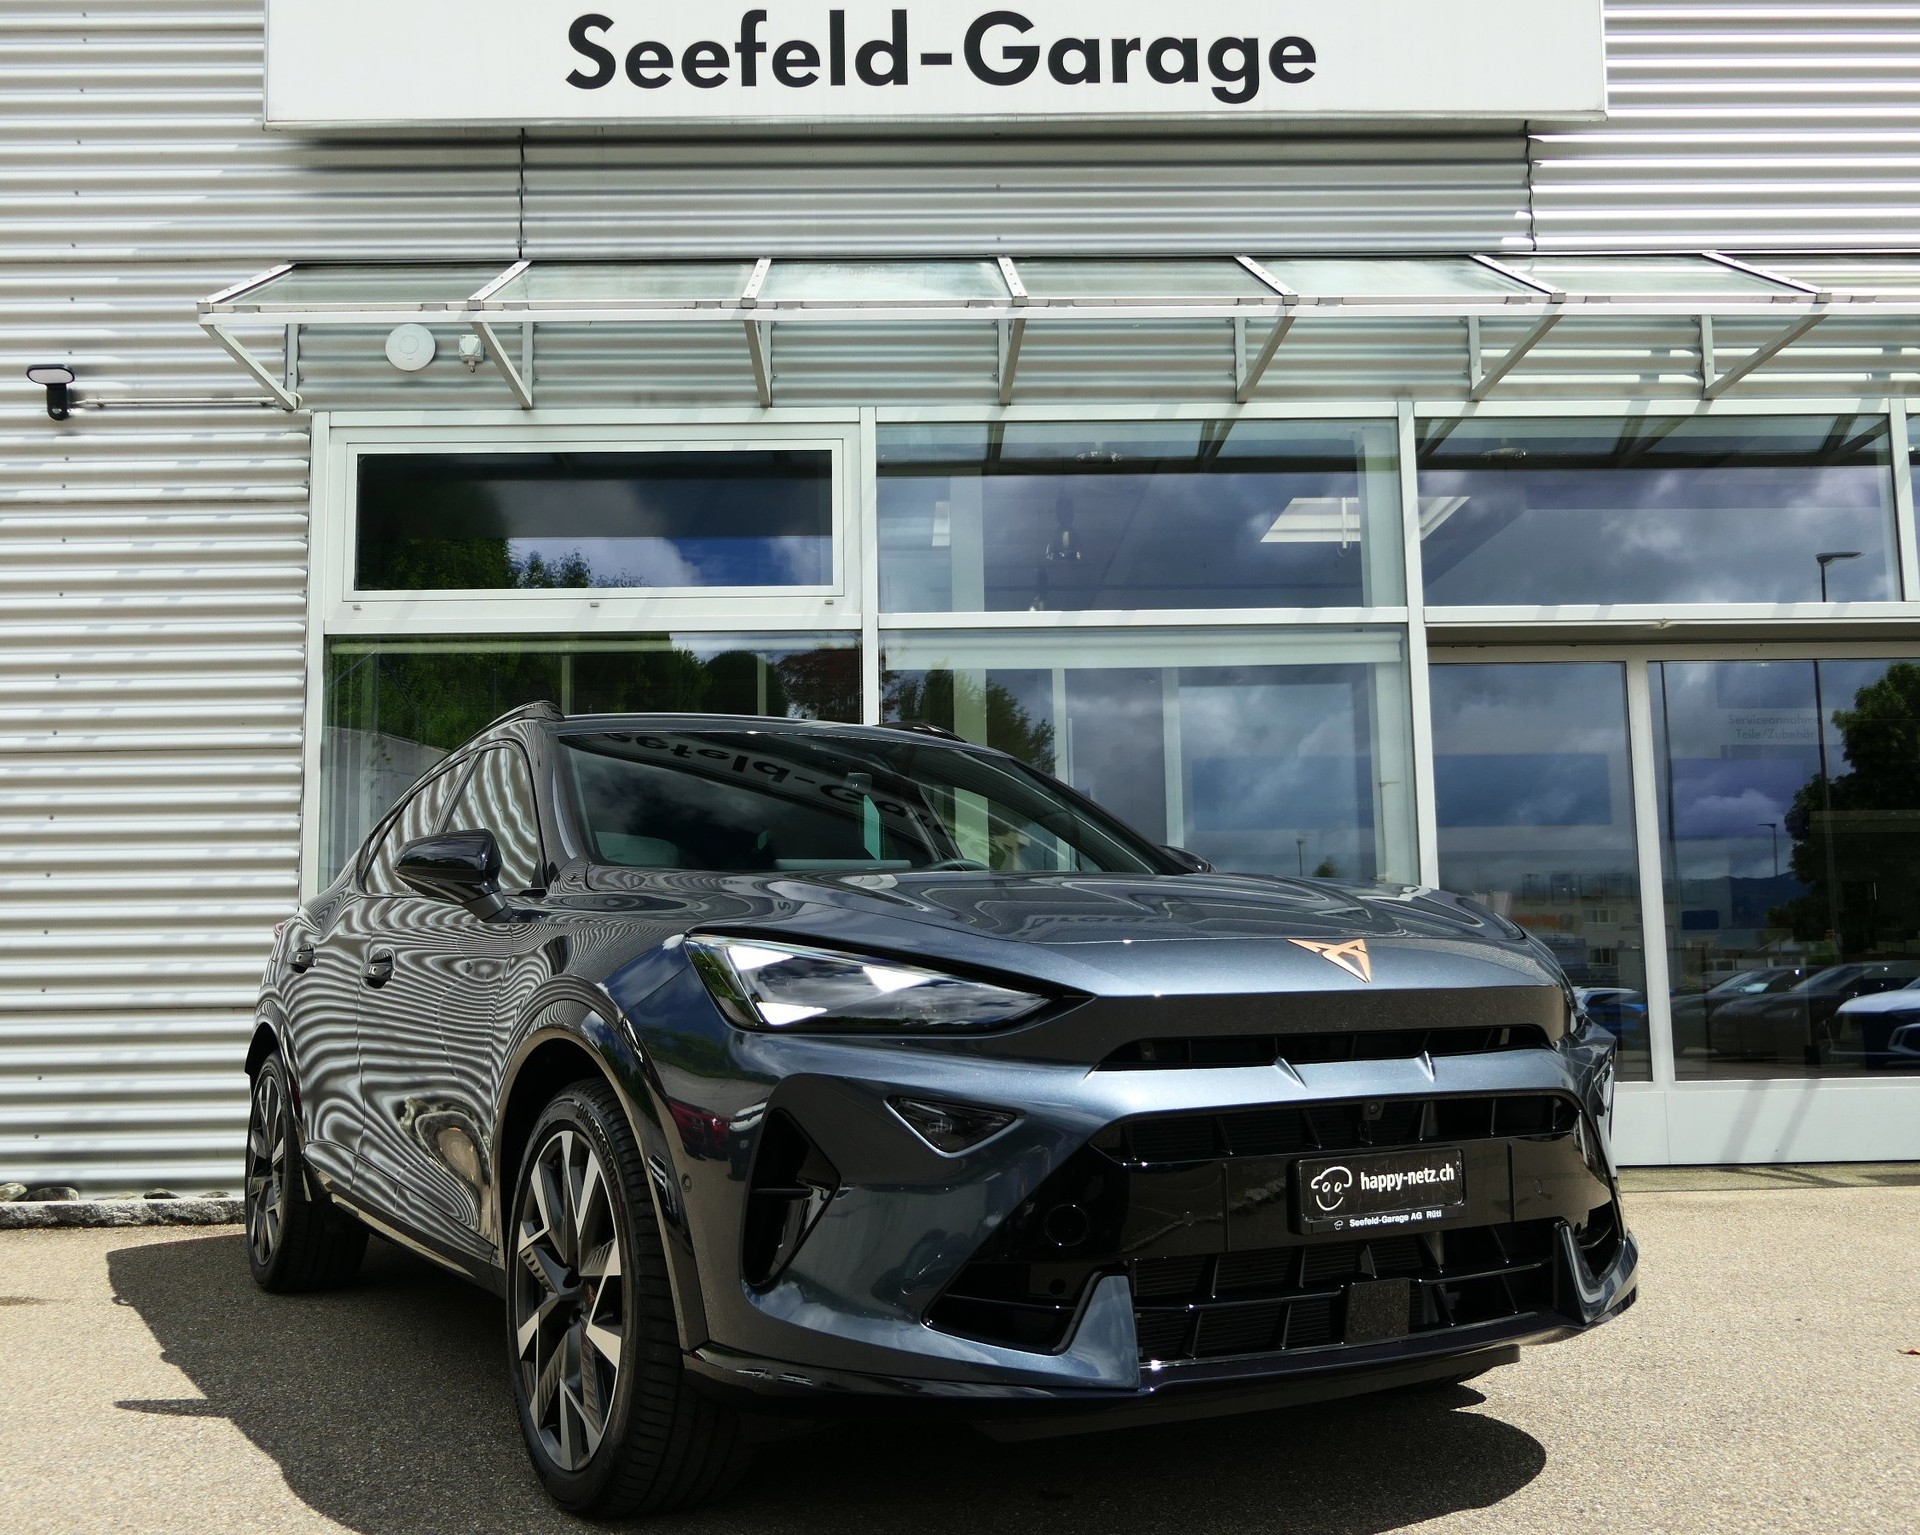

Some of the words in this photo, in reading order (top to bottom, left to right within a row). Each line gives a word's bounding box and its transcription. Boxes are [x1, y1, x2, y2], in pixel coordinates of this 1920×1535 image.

[565, 9, 1316, 104] Seefeld-Garage
[1360, 1163, 1455, 1192] happy-netz.ch
[1349, 1214, 1409, 1227] Seefeld-Garage
[1411, 1212, 1423, 1220] AG
[1426, 1209, 1442, 1219] Rüti
